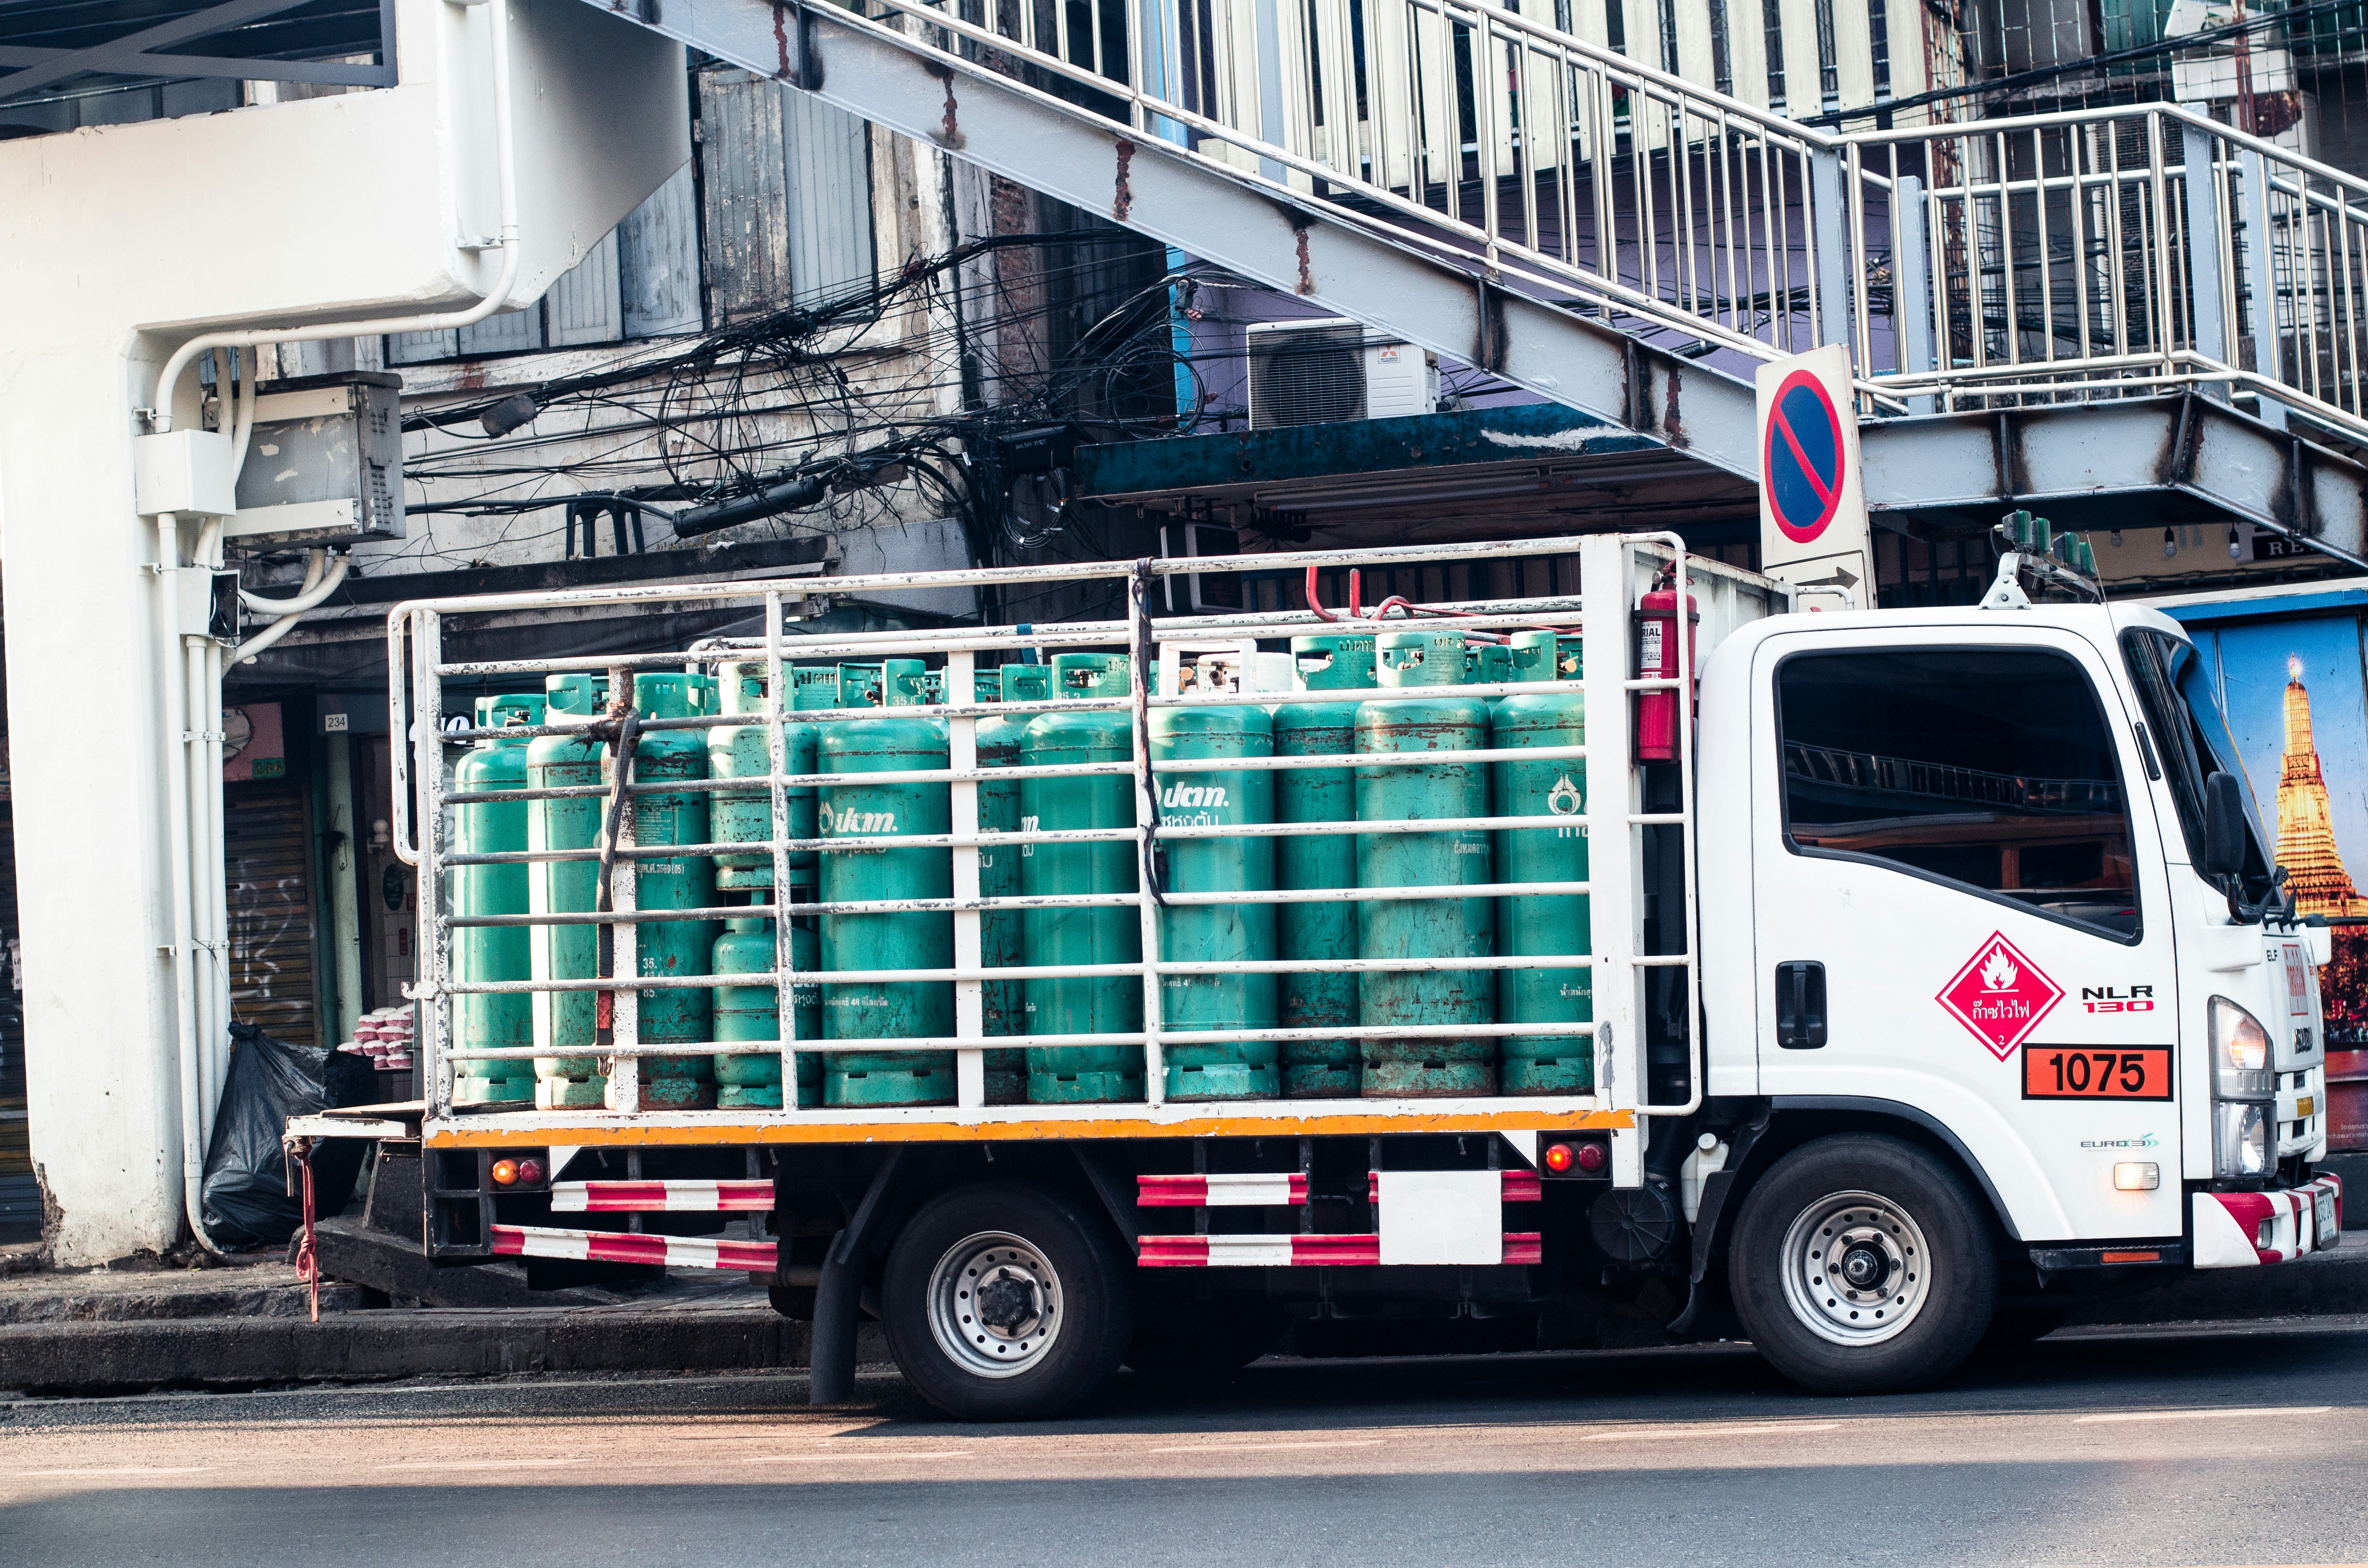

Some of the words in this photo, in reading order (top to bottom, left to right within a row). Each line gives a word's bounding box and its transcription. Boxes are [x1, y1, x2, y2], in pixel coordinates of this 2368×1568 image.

[2268, 541, 2314, 555] RE
[1641, 628, 1661, 637] RIAL
[328, 717, 345, 728] 234
[1163, 781, 1229, 808] ปตท.
[835, 807, 898, 833] ปตท.
[2267, 950, 2278, 962] ELF
[2082, 985, 2153, 1000] NLR
[1973, 999, 2030, 1019] ก๊าซไวไฟ
[2083, 1001, 2154, 1013] 130
[1998, 1035, 2005, 1045] 2
[2049, 1053, 2146, 1092] 1075
